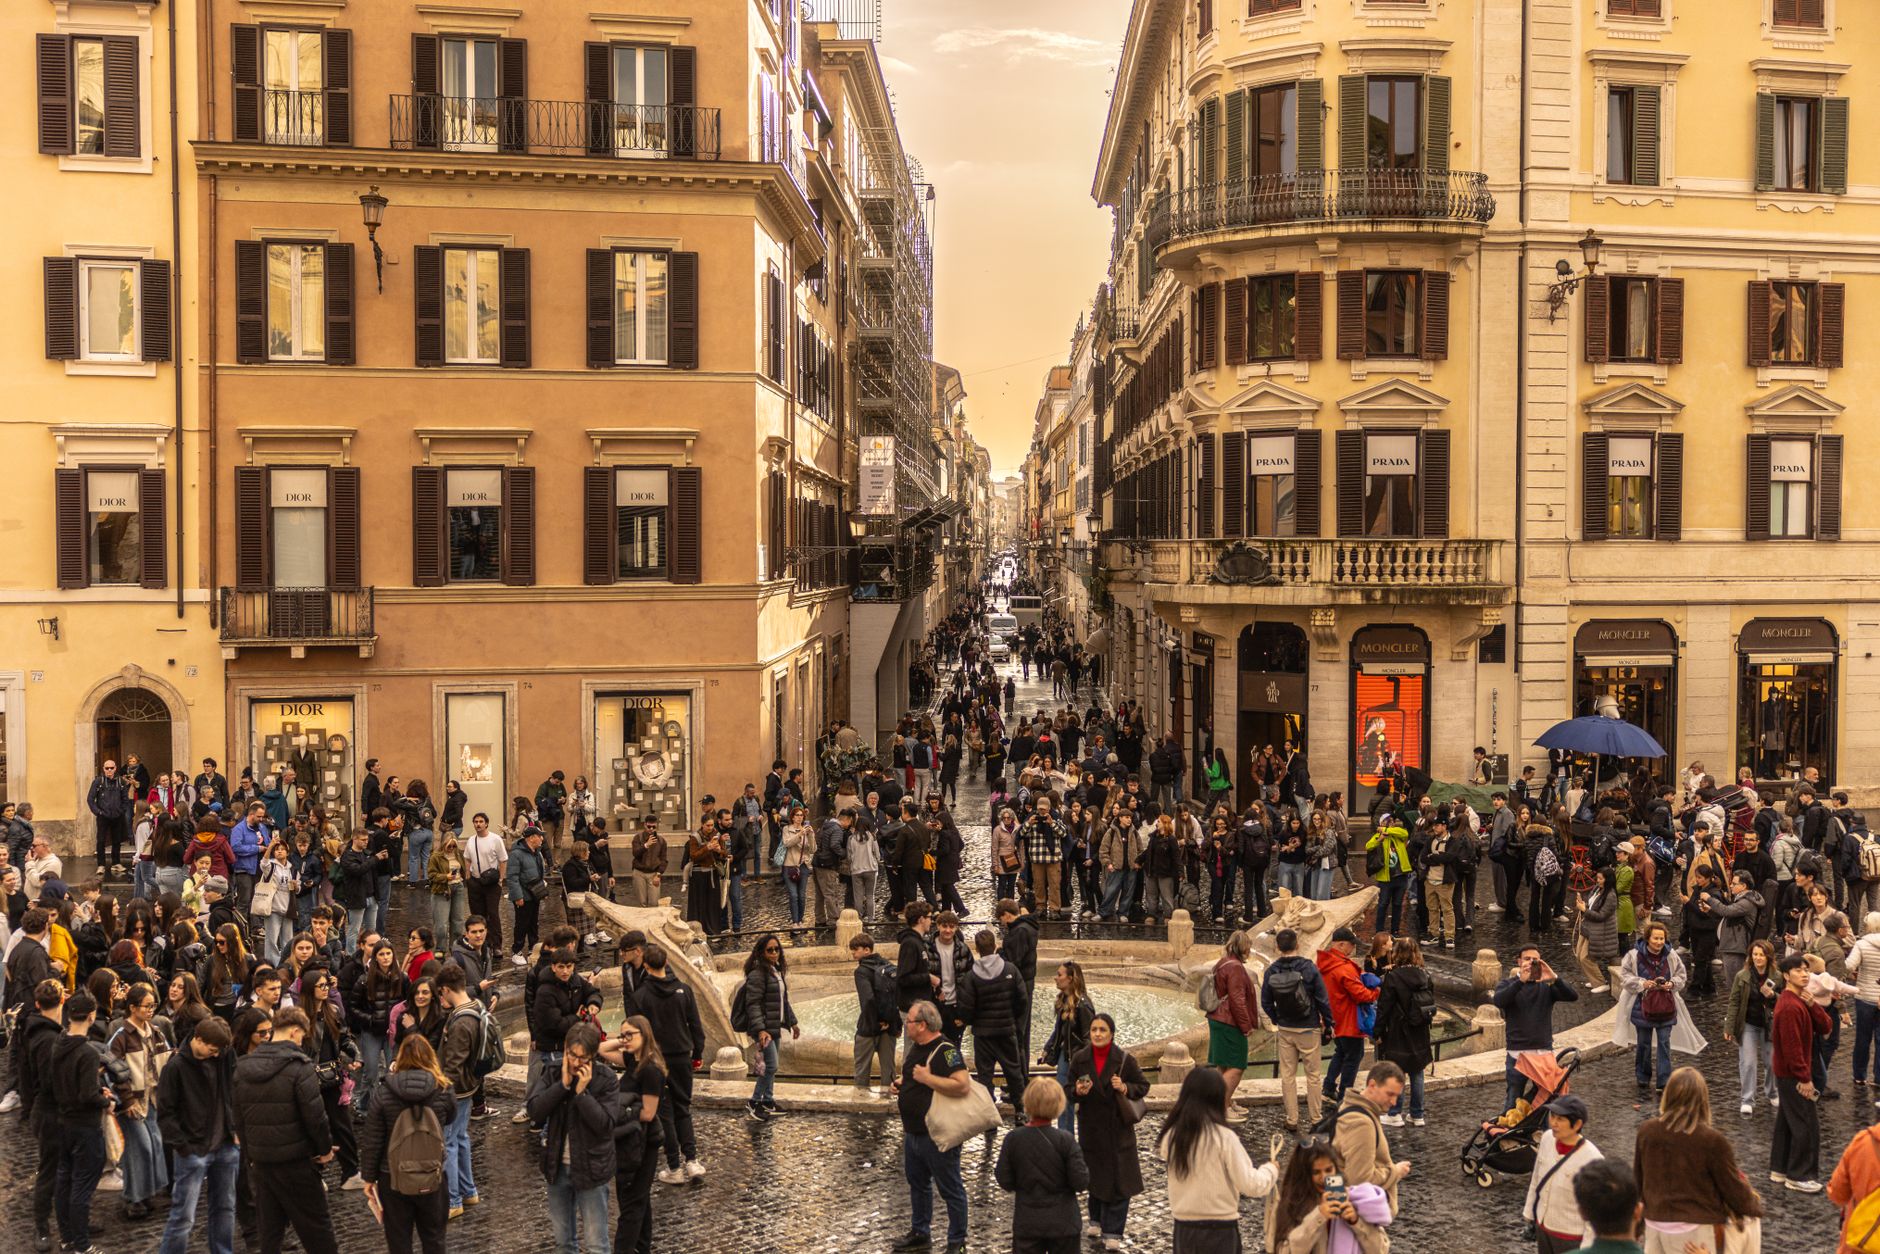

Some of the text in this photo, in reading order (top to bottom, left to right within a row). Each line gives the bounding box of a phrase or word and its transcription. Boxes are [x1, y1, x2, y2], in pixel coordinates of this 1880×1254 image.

[1256, 458, 1290, 467] PRADA
[1372, 458, 1410, 466] PRADA
[1611, 459, 1646, 468] PRADA
[1773, 465, 1806, 473] PRADA
[286, 493, 312, 502] DIOR
[462, 493, 488, 501] DIOR
[630, 492, 655, 501] DIOR
[99, 498, 126, 506] DIOR
[1598, 630, 1651, 640] MONCLER
[1761, 628, 1812, 638] MONCLER
[1361, 643, 1420, 653] MONCLER
[31, 672, 43, 681] 72
[624, 697, 664, 709] DIOR
[280, 703, 324, 716] DIOR
